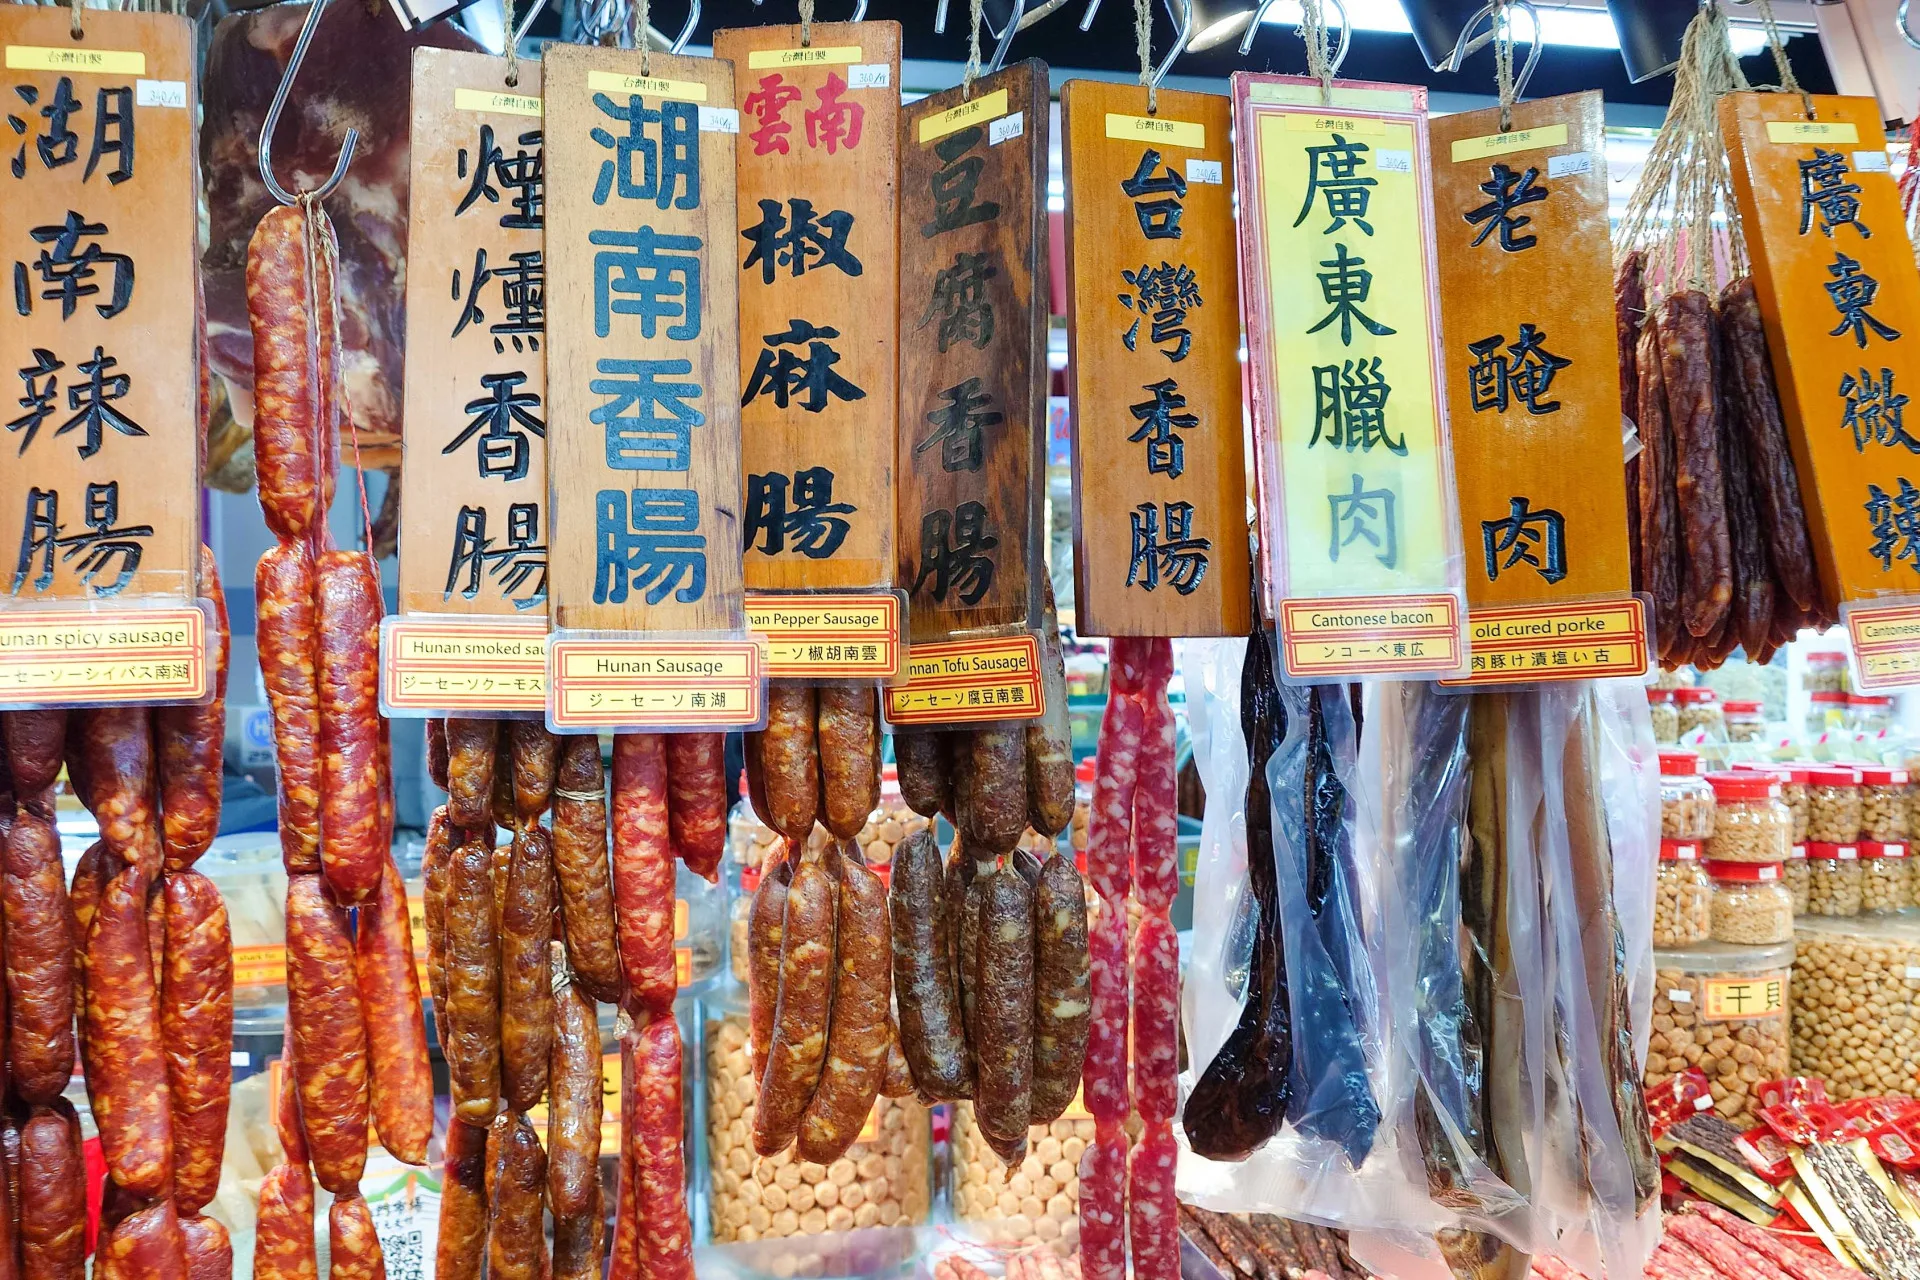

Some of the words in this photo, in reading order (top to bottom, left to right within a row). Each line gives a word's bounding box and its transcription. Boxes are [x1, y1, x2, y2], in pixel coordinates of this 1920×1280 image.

[47, 51, 102, 64] 台灣自製
[781, 50, 827, 63] 台灣自製
[622, 76, 670, 92] 台灣自製
[744, 72, 865, 156] 雲南
[1135, 120, 1174, 132] 台灣自製
[5, 76, 154, 597] 湖南辣腸
[588, 92, 706, 605] 湖南香腸
[1293, 133, 1408, 570] 廣東臘肉
[442, 125, 546, 610] 煙燻香腸
[909, 126, 1002, 607] 豆腐香腸
[1116, 148, 1212, 596] 台灣香腸
[1464, 163, 1572, 585] 老醃肉
[741, 198, 866, 560] 椒麻腸
[774, 613, 821, 627] Pepper
[824, 612, 879, 628] Sausage
[1312, 613, 1387, 628] Cantonese
[1391, 611, 1434, 624] bacon
[1475, 623, 1501, 638] old
[1505, 620, 1551, 636] cured
[1557, 617, 1605, 636] porke
[54, 630, 103, 649] spicy
[109, 629, 185, 648] sausage
[413, 641, 461, 654] Hunan
[465, 641, 521, 655] smoked
[597, 658, 651, 673] Hunan
[656, 658, 723, 676] Sausage
[942, 657, 970, 673] Tofu
[972, 656, 1027, 672] Sausage
